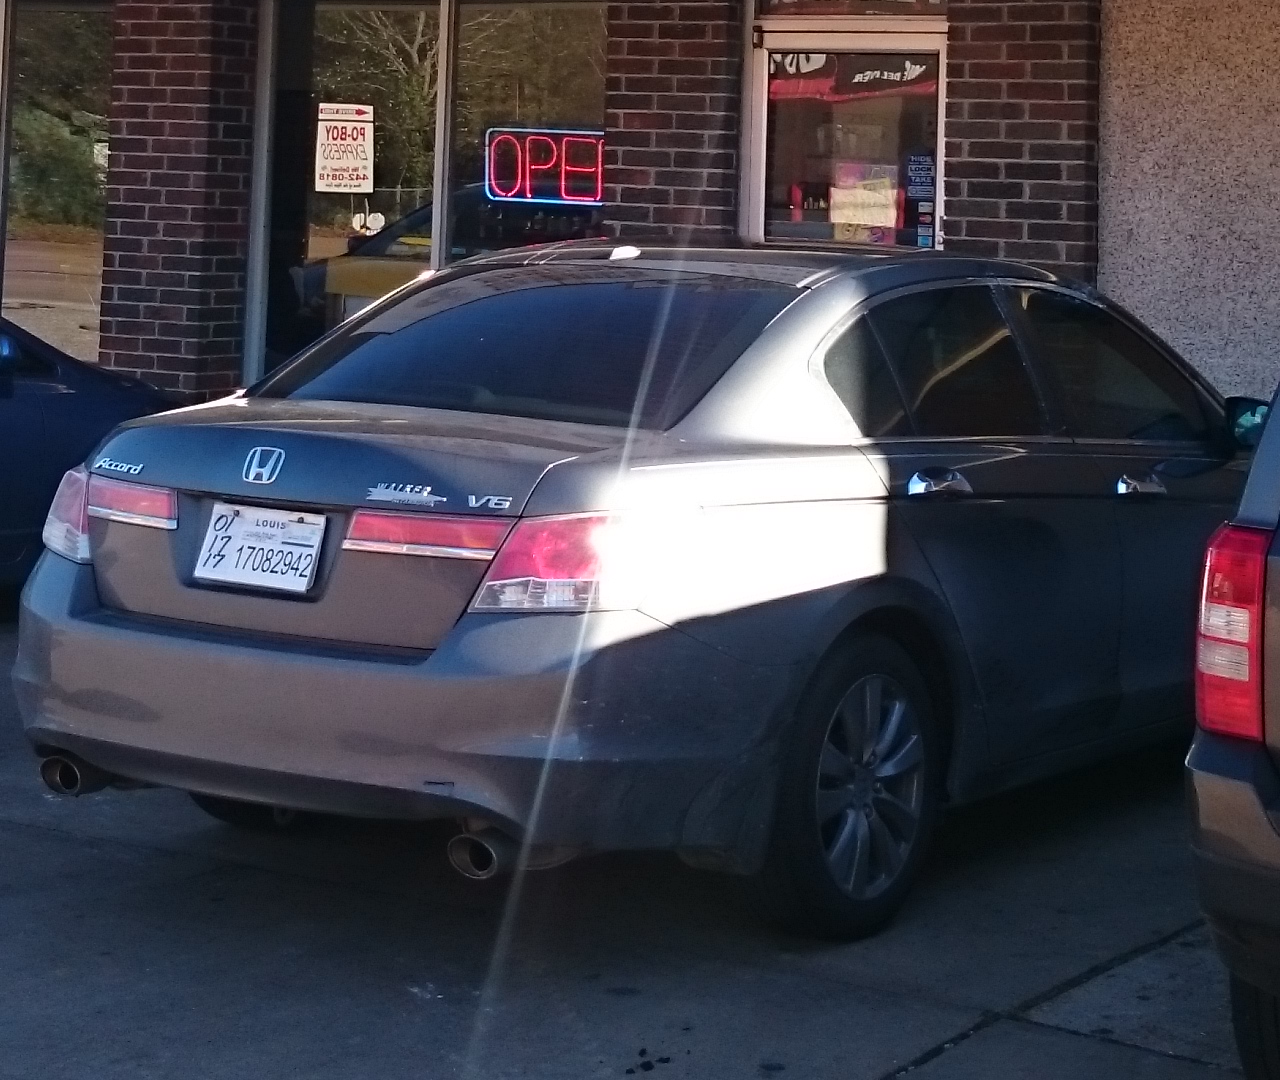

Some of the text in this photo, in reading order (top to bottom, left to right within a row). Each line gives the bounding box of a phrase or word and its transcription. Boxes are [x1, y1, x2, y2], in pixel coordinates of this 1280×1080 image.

[489, 134, 605, 202] OPE
[94, 457, 144, 474] Accord
[467, 494, 513, 509] V6
[234, 544, 313, 578] 17082942
